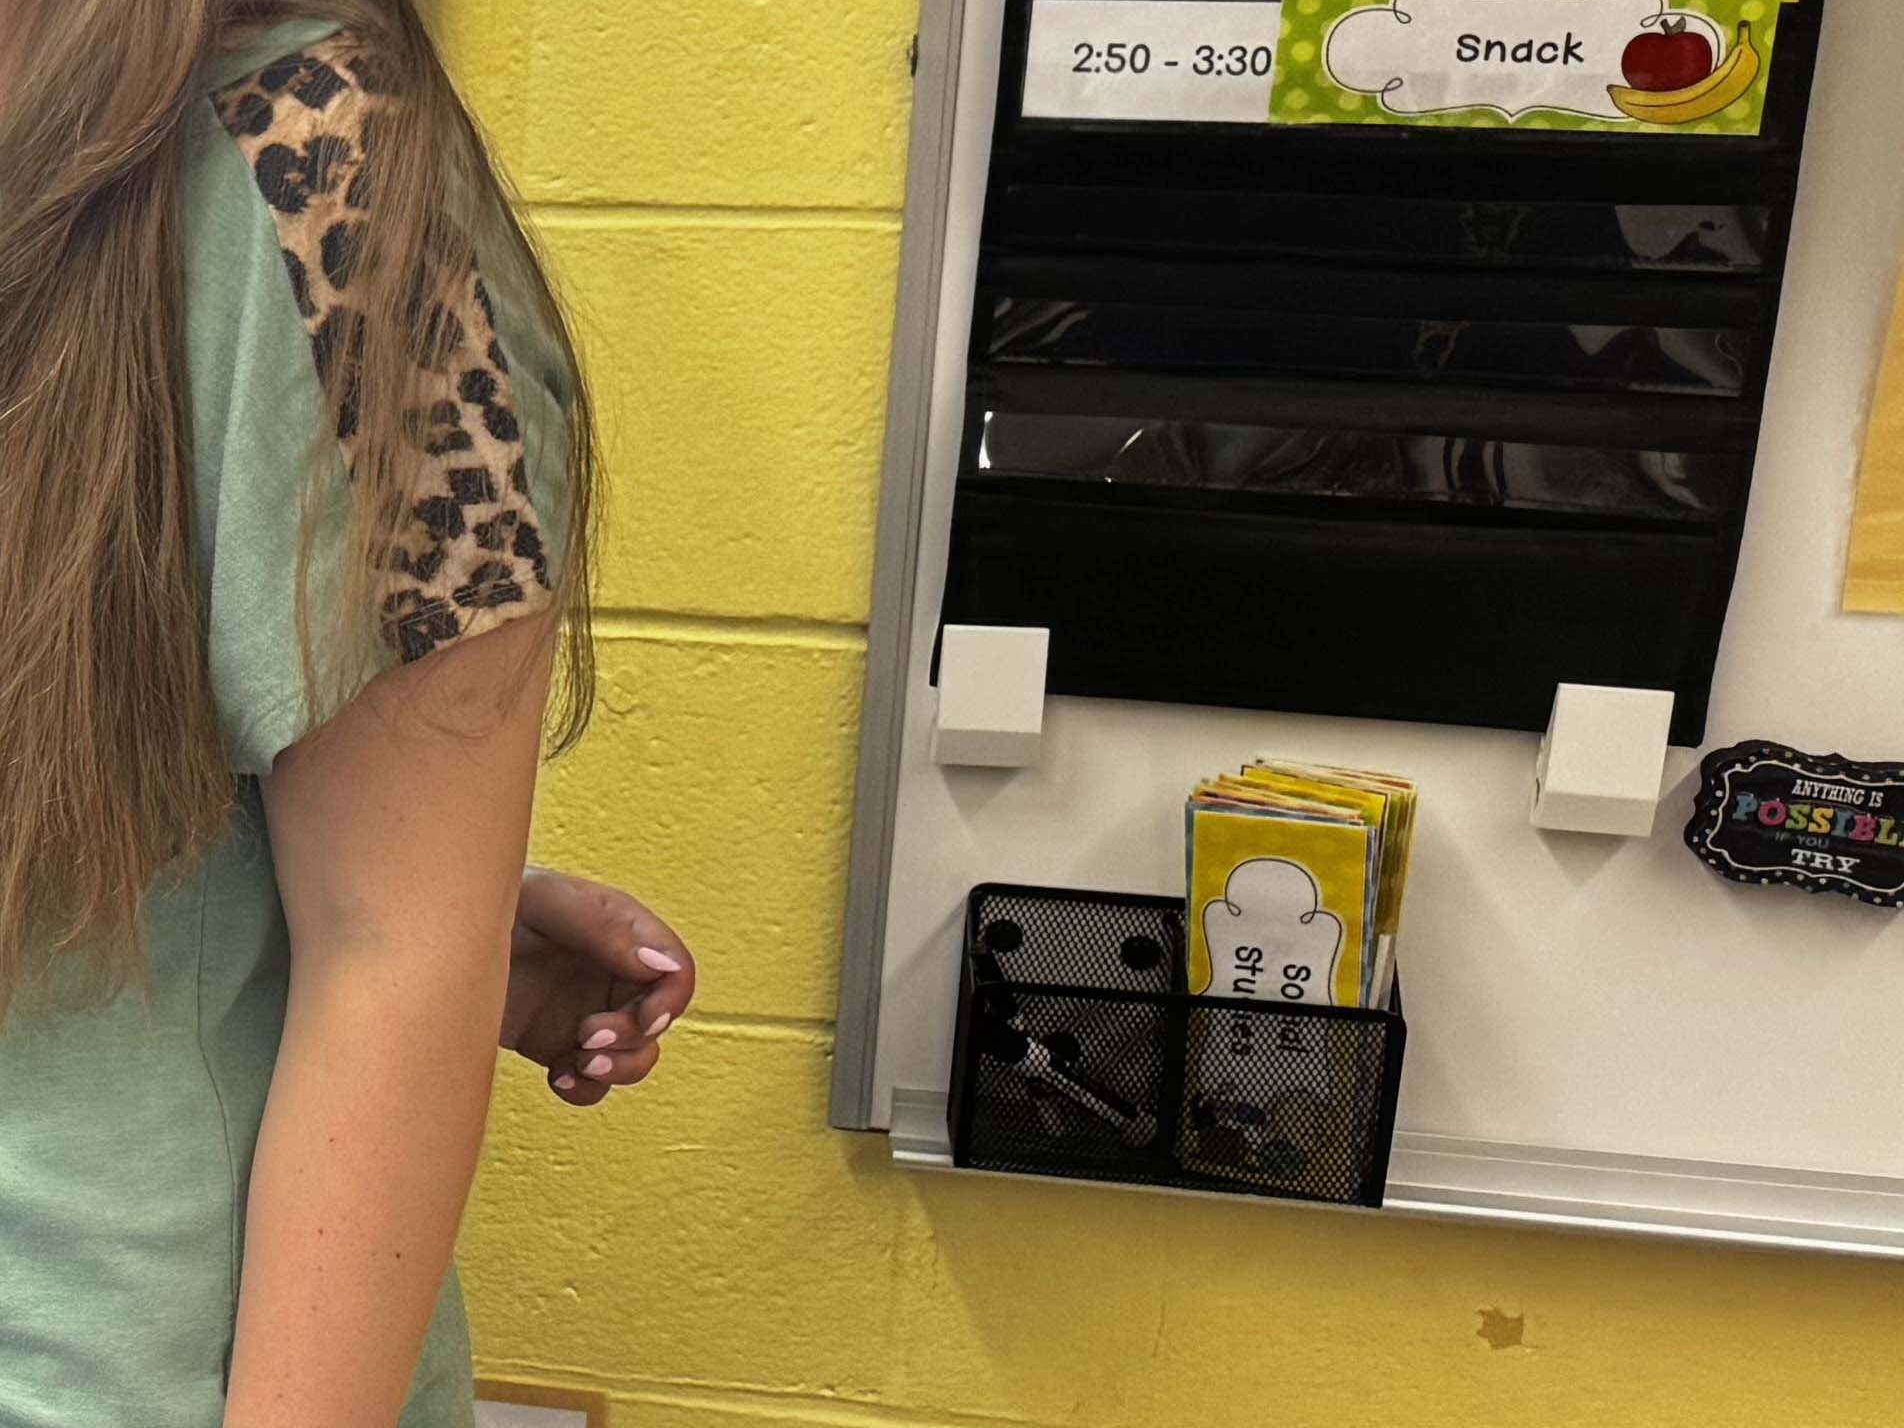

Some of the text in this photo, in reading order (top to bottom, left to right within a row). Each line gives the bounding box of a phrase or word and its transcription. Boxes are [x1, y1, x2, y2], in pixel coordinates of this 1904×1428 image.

[1072, 43, 1151, 74] 2:50
[1192, 45, 1272, 77] 3:30
[1455, 31, 1585, 65] Snack
[1792, 778, 1884, 808] ANYTHING IS
[1731, 794, 1904, 848] POSSIBL
[1796, 834, 1830, 849] YOU
[1792, 848, 1860, 873] TRY
